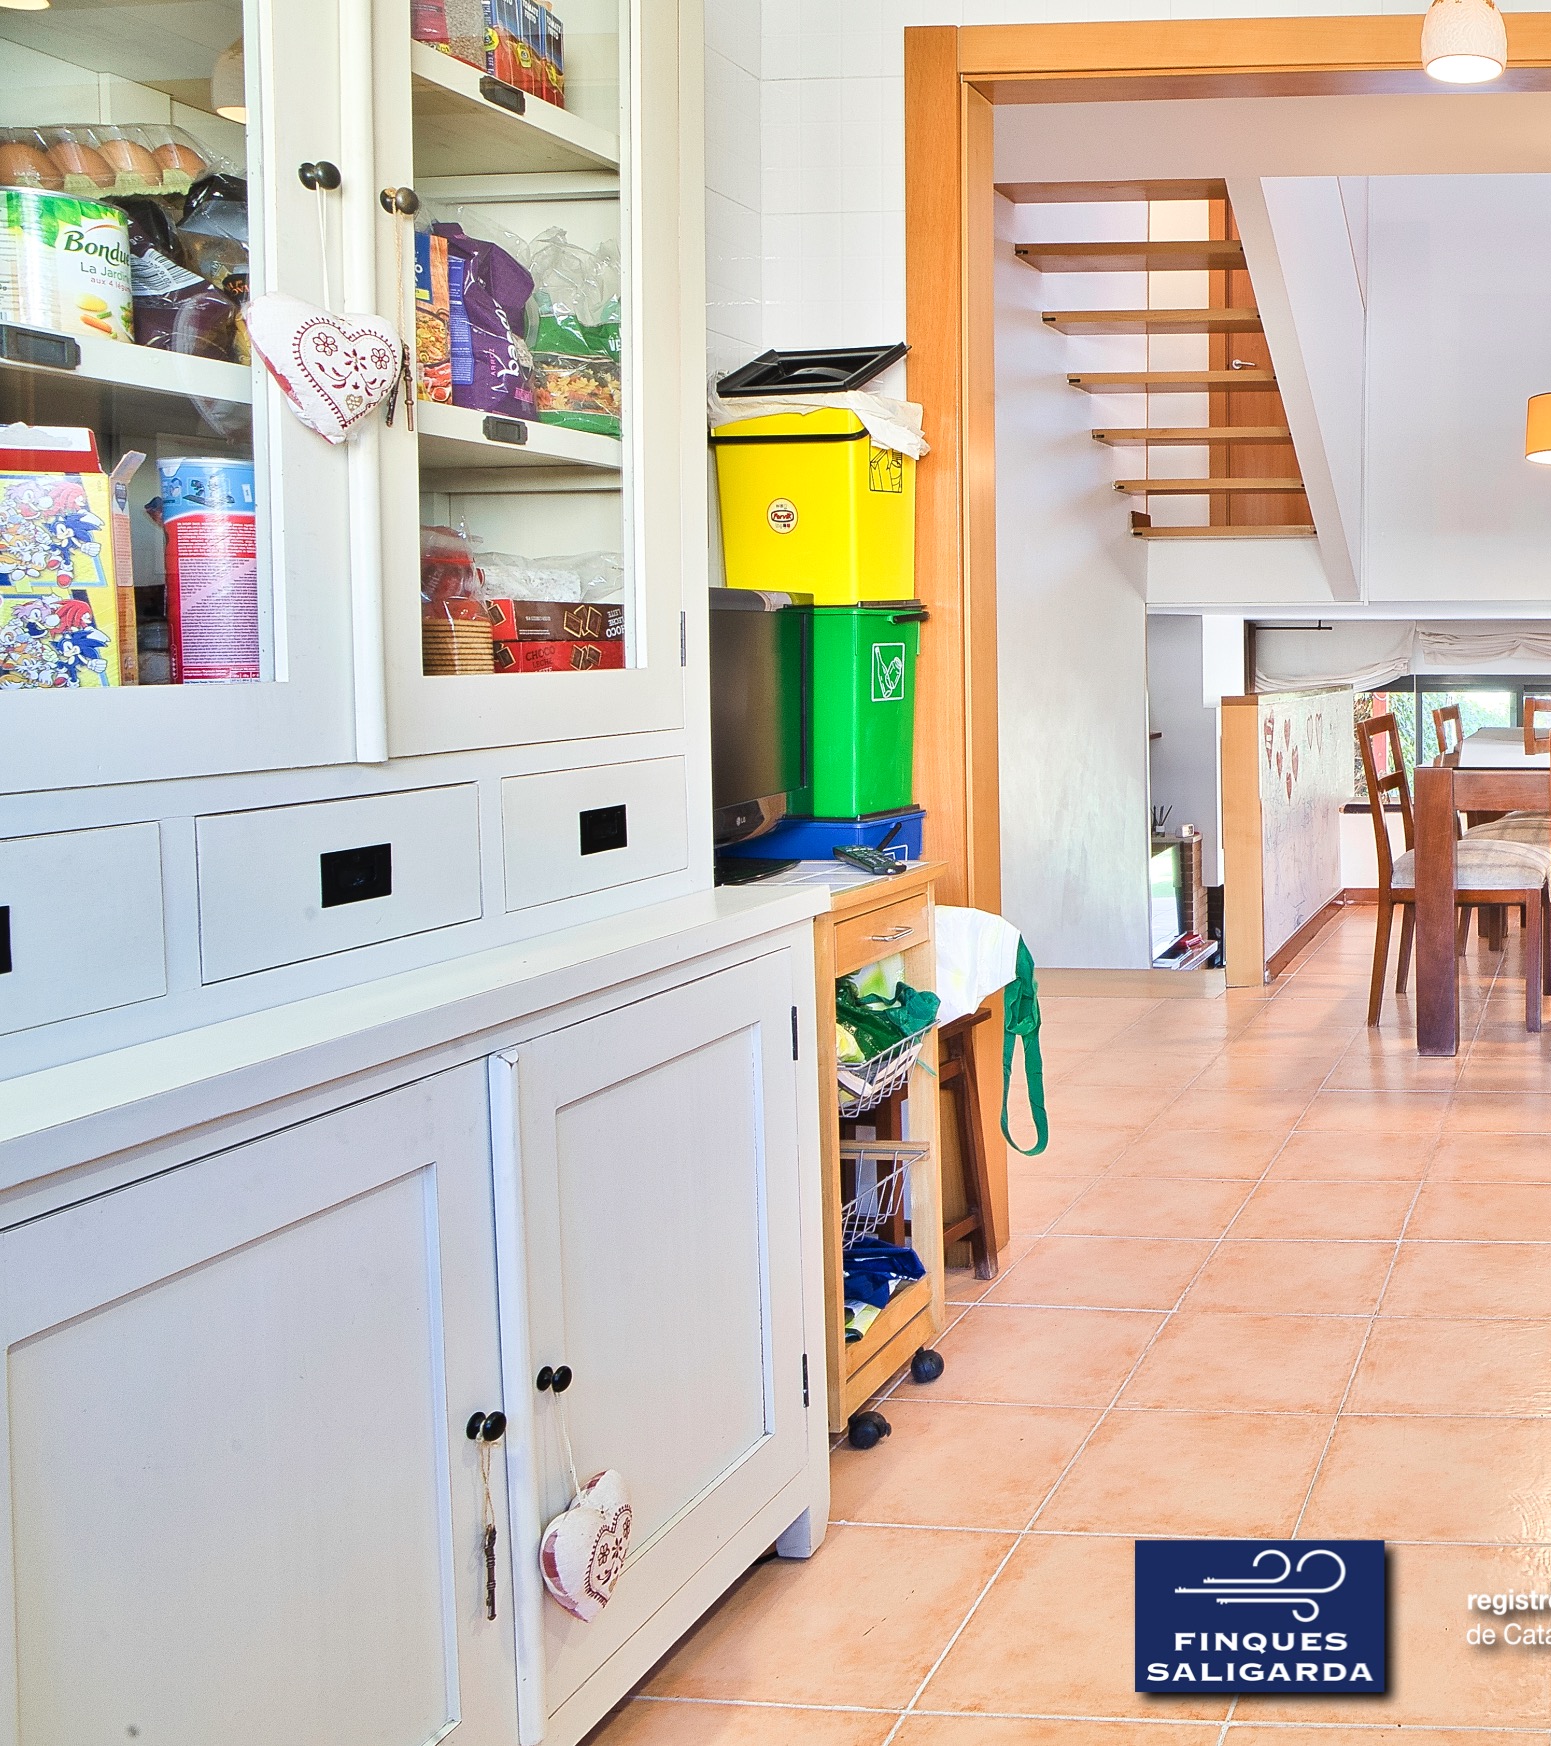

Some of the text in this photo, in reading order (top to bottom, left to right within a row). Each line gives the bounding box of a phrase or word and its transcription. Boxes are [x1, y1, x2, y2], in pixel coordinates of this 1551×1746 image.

[80, 261, 97, 274] La
[90, 277, 106, 286] aux
[525, 645, 555, 662] CHOCO
